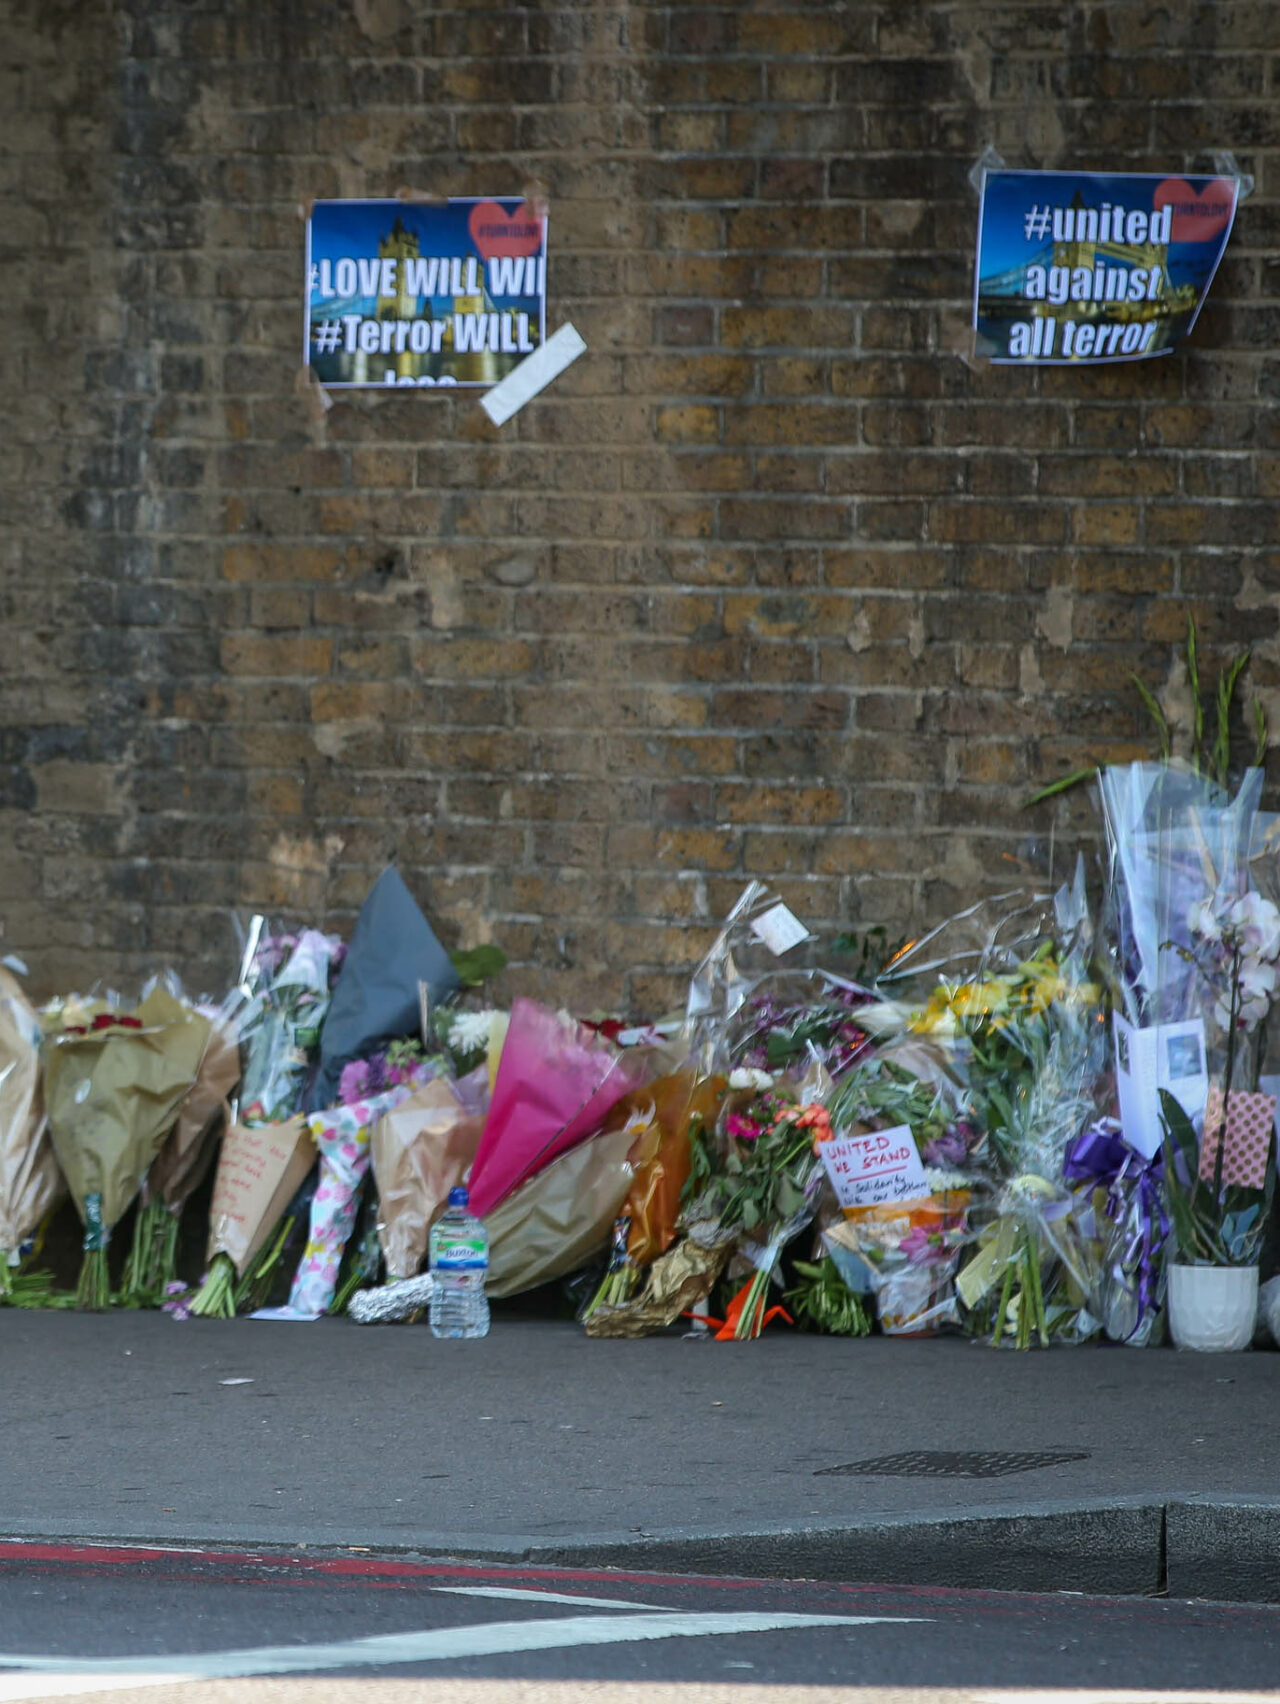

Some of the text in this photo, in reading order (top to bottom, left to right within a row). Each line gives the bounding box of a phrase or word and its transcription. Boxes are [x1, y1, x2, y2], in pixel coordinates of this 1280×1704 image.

[1024, 203, 1173, 245] #united
[404, 256, 482, 297] WILL
[1025, 261, 1163, 305] against
[315, 312, 535, 354] #Terror WILL
[1008, 317, 1158, 356] all terror
[826, 1136, 890, 1160] UNITED
[861, 1146, 911, 1170] STAND
